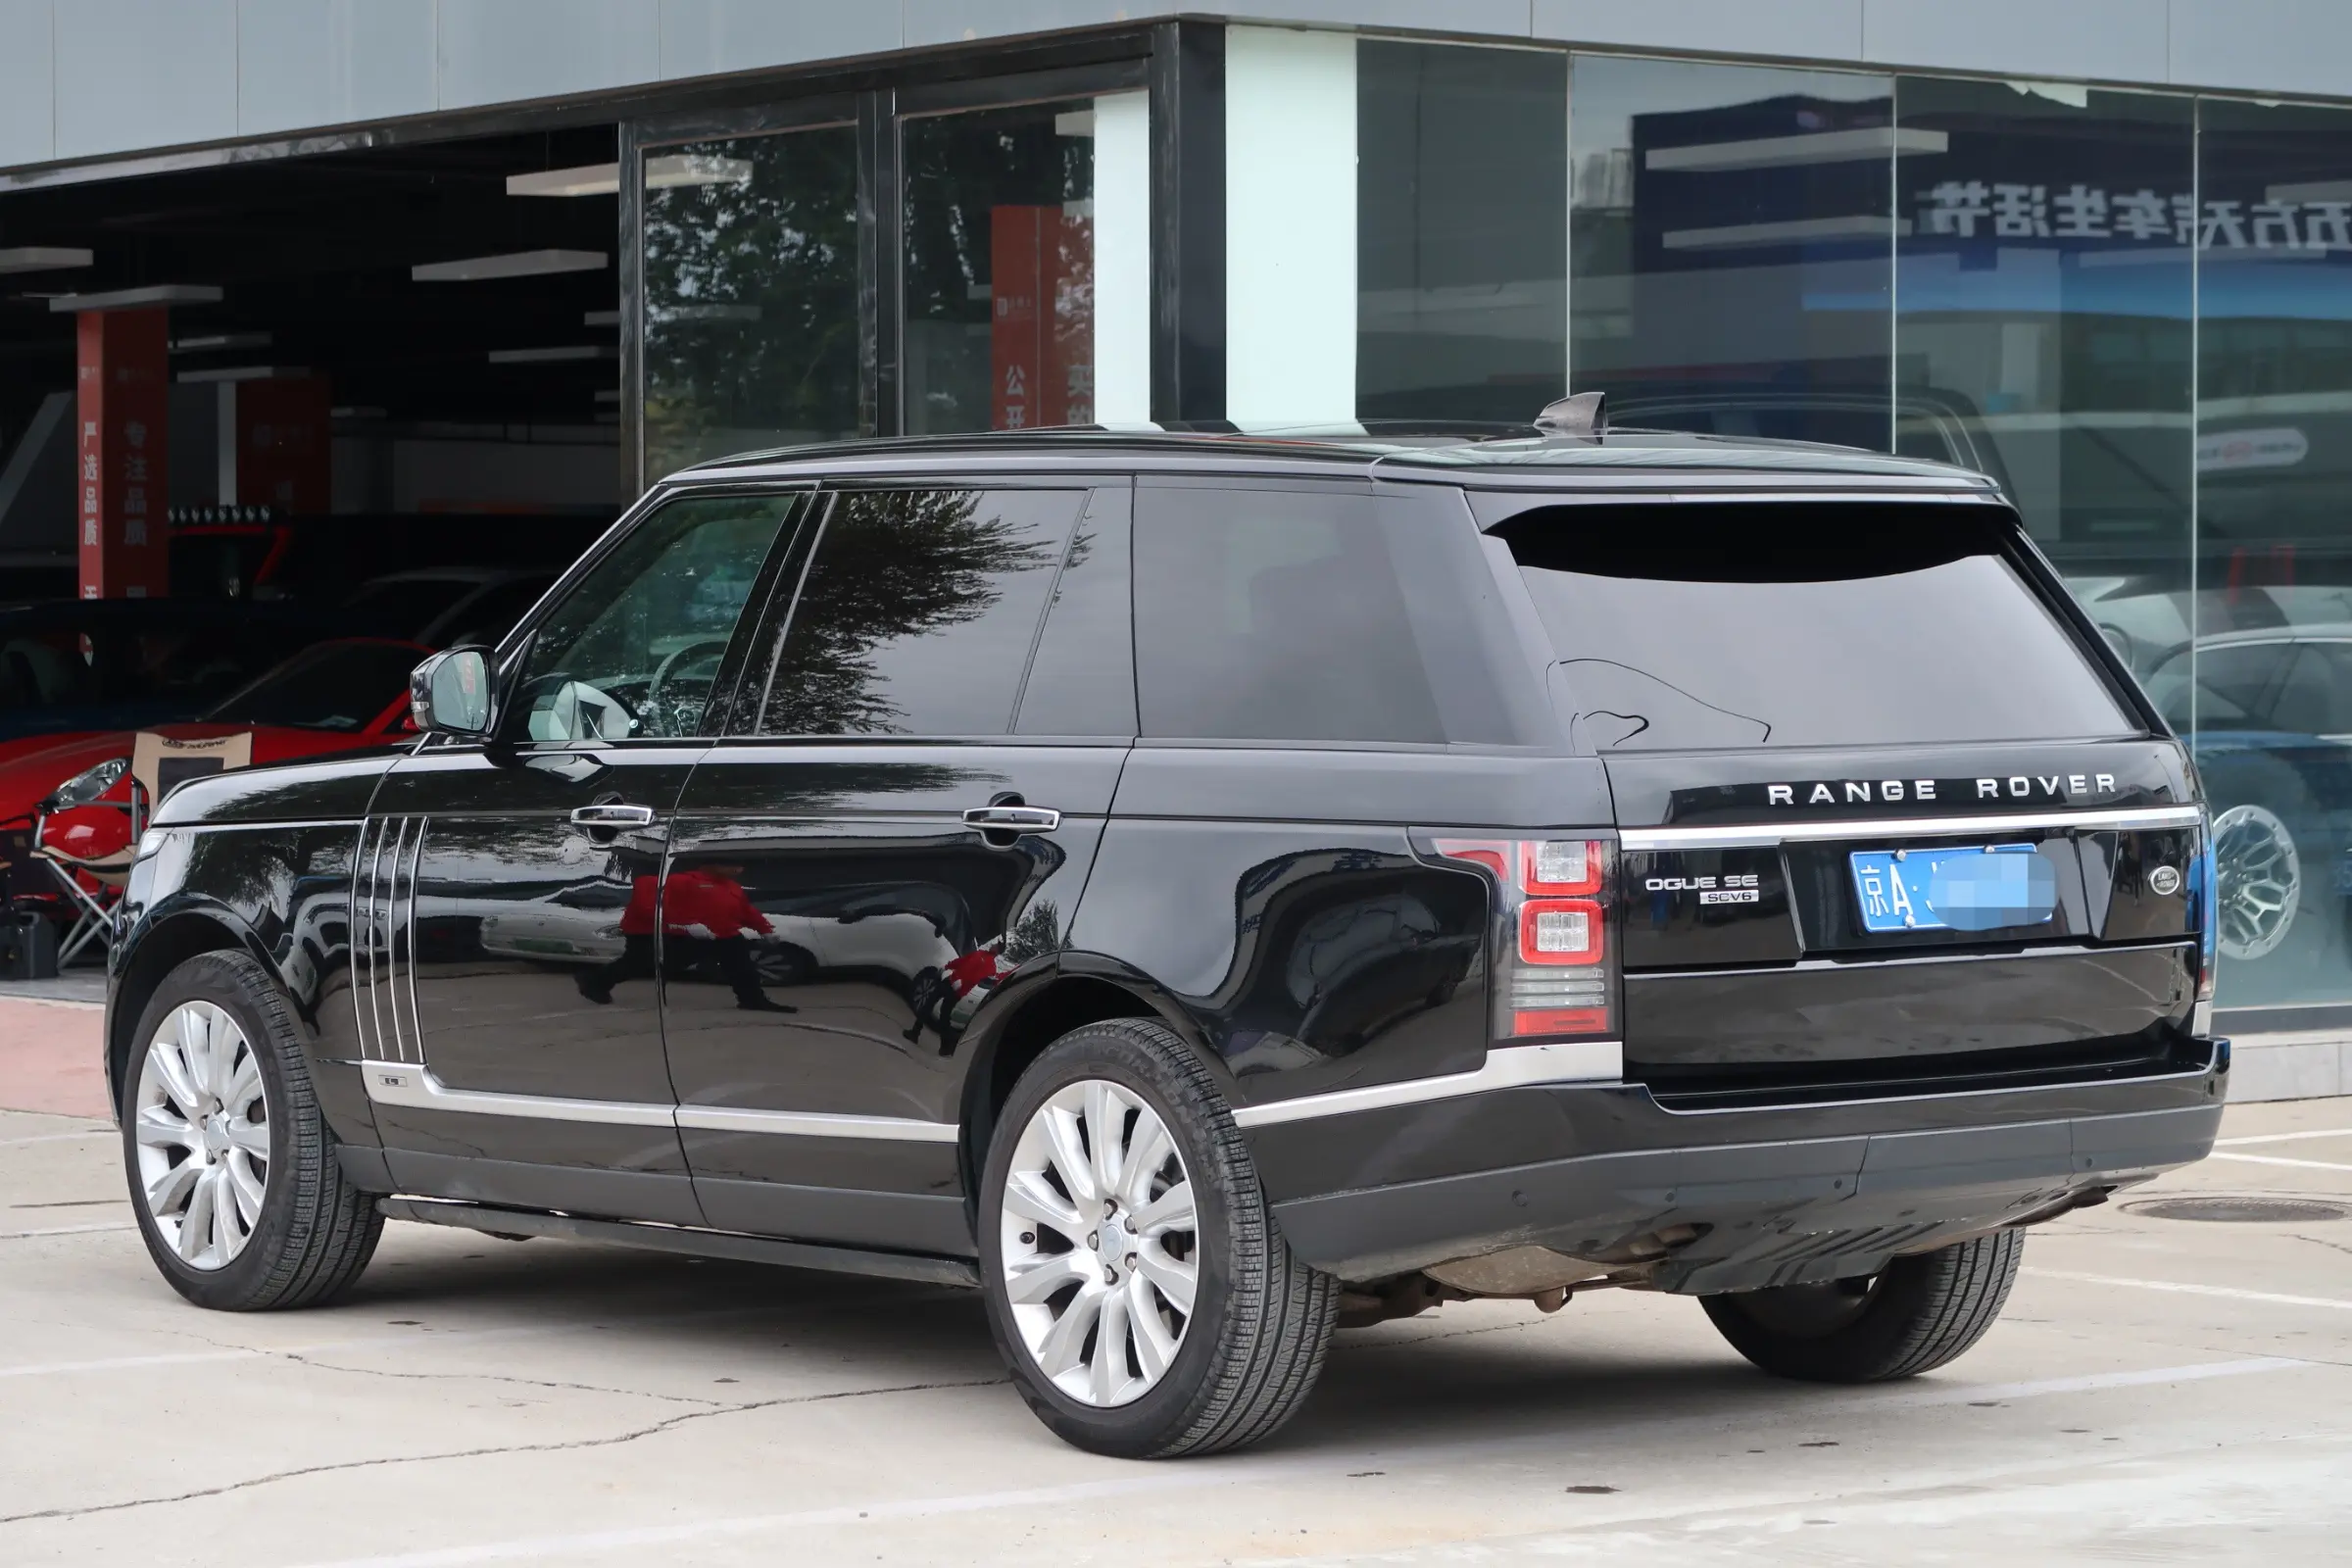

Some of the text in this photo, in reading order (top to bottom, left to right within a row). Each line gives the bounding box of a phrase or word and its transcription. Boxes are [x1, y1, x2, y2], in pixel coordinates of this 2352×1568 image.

[83, 420, 98, 547] 严选品质
[123, 419, 148, 547] 专注品质
[1768, 773, 2117, 806] RANGE ROVER
[1644, 874, 1759, 891] OGUE SE
[1707, 892, 1752, 903] SCV6
